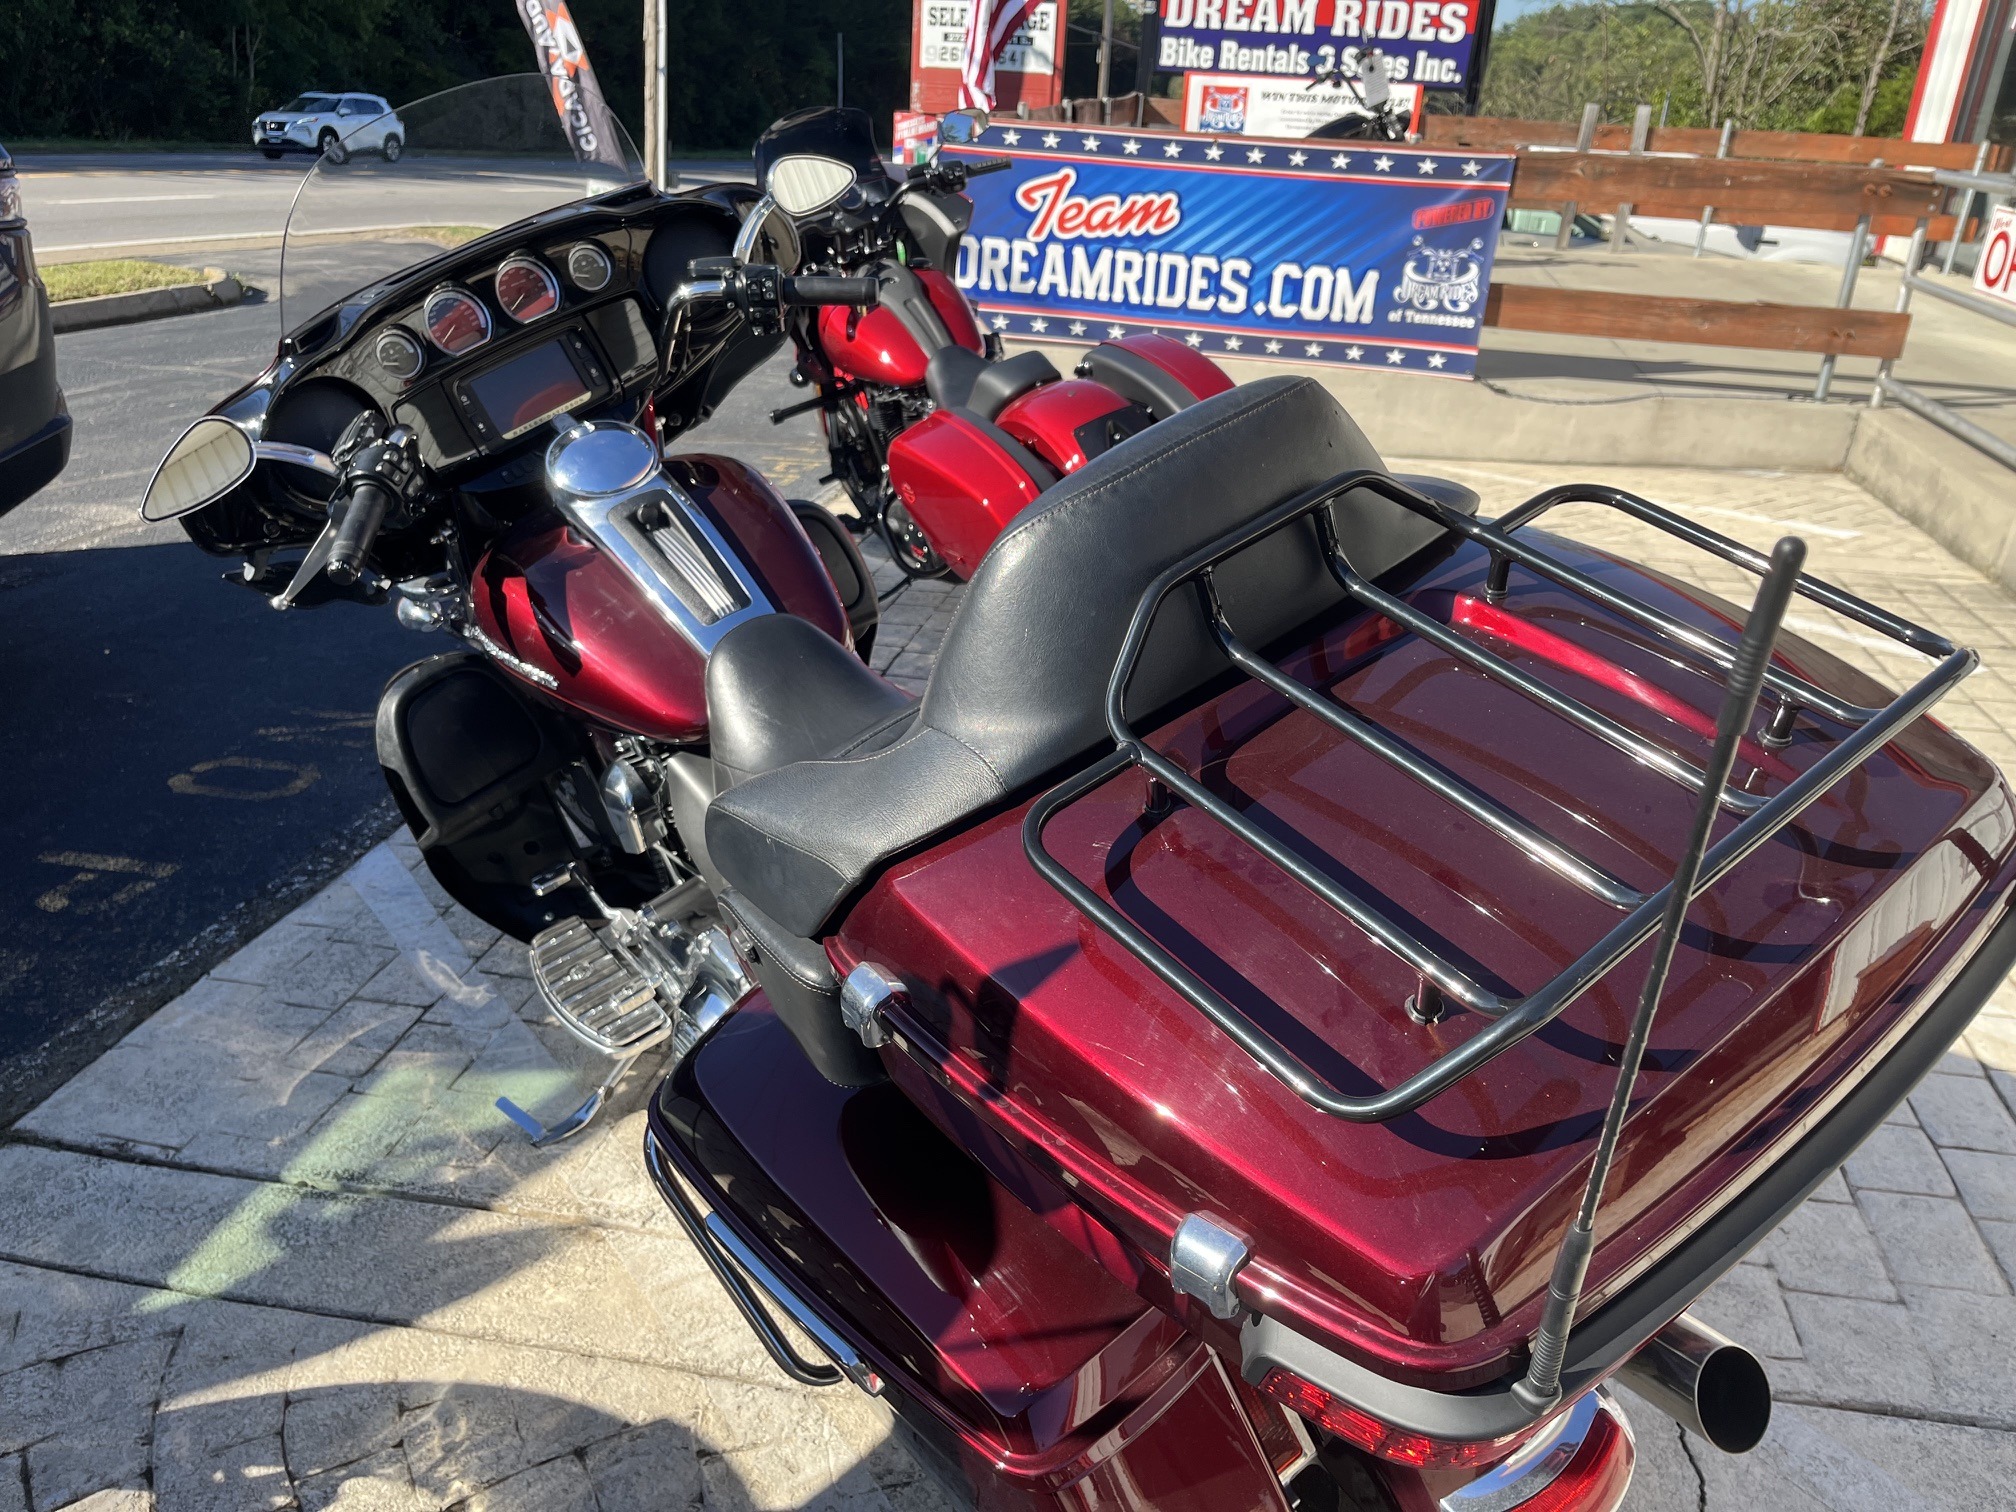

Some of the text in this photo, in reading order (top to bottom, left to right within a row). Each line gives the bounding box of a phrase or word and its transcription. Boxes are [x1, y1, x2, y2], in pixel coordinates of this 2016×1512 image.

[1164, 0, 1469, 44] DREAM RIDES
[1159, 36, 1215, 69] Bike
[1218, 39, 1311, 75] Rentals
[1413, 50, 1462, 83] Inc.
[1017, 168, 1181, 241] Team
[955, 234, 1380, 324] DREAMRIDES.COM
